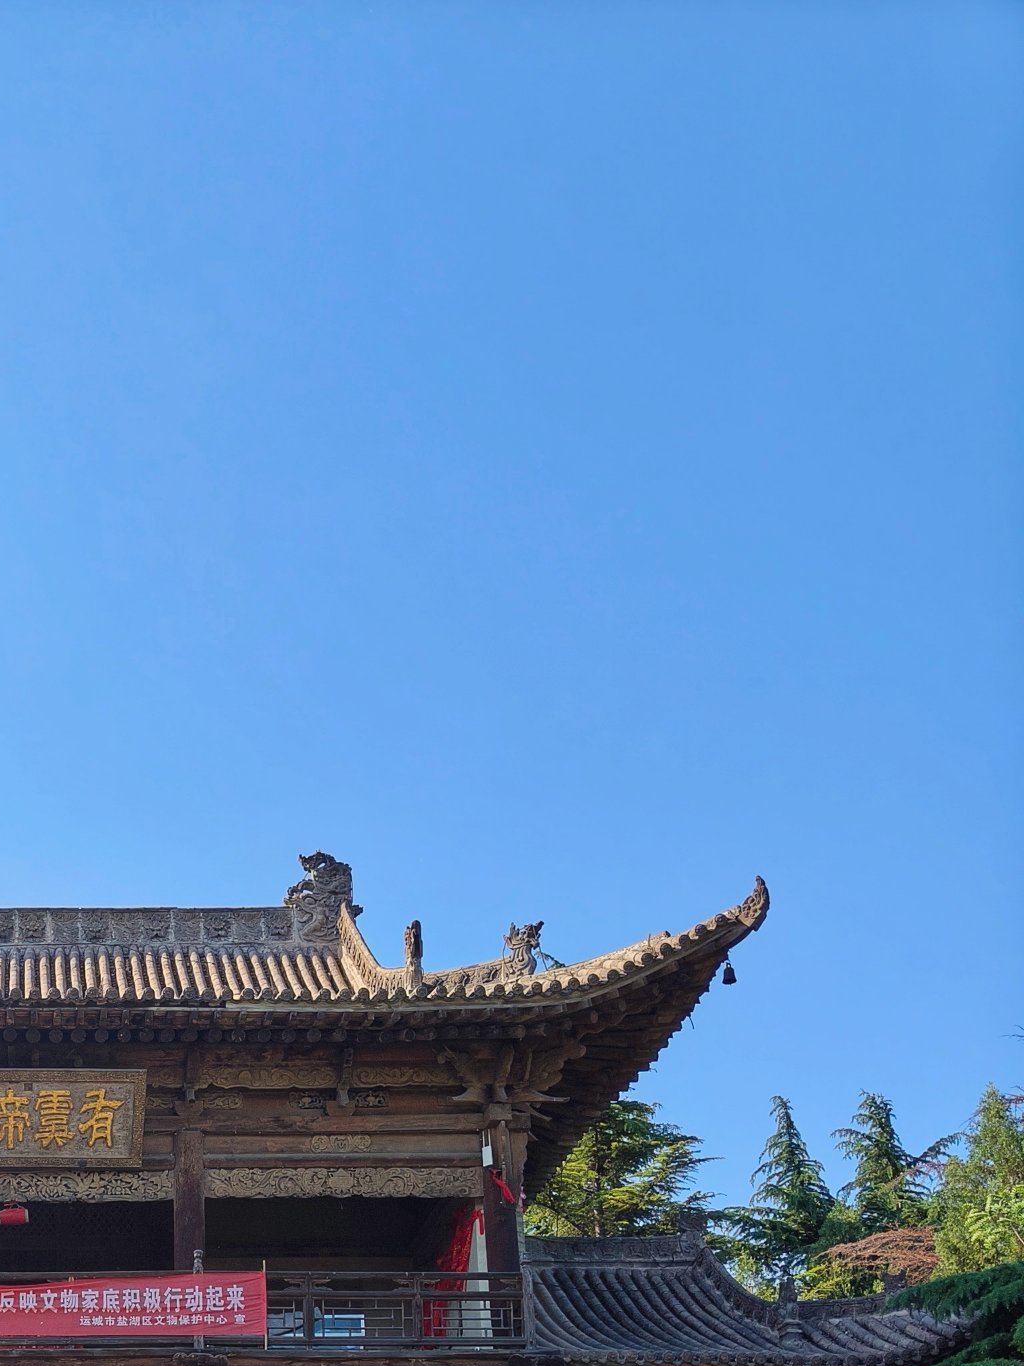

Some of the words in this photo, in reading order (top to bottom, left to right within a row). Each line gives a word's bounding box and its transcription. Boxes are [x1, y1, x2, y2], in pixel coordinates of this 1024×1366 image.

[79, 1313, 228, 1327] 运城市盐湖区文物保护中心
[233, 1313, 247, 1326] 宣
